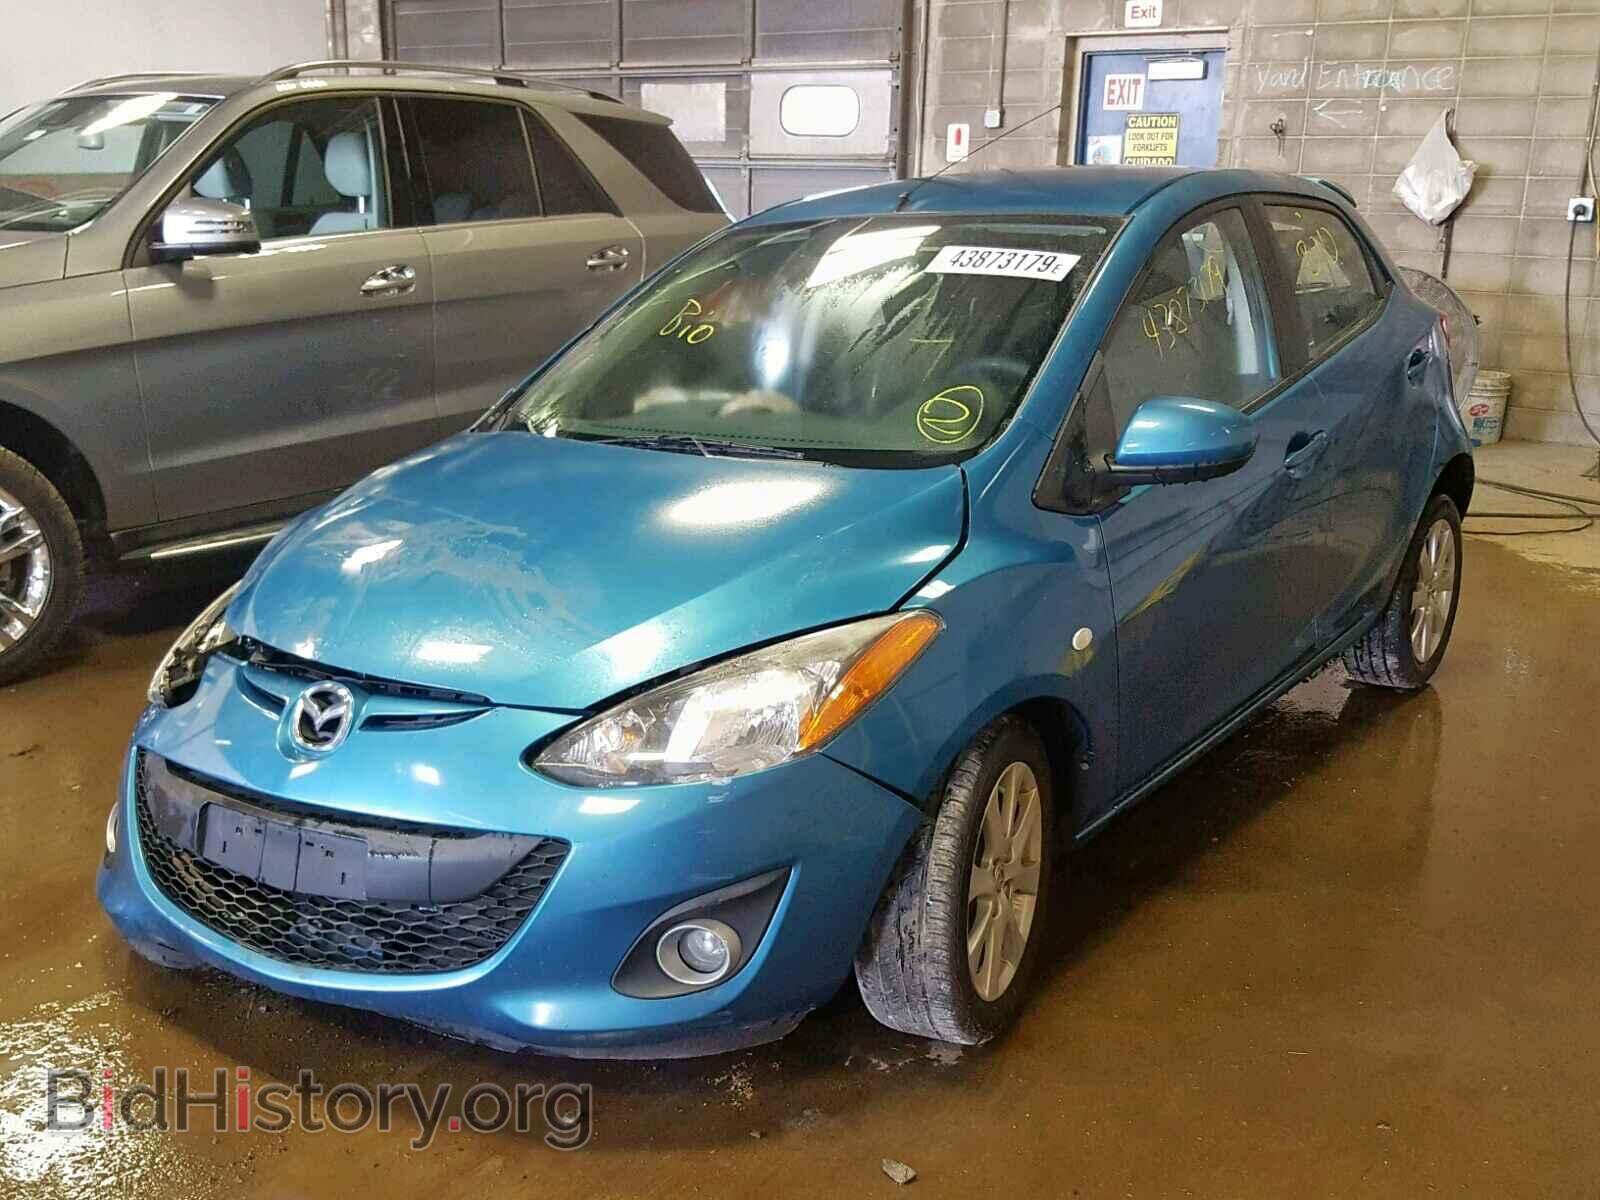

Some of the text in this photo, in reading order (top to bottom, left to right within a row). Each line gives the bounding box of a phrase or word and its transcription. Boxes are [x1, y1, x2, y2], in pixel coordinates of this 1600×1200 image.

[1131, 5, 1157, 19] Exit
[1106, 78, 1141, 105] EXIT
[1128, 115, 1177, 128] CAUTION
[1128, 132, 1146, 141] LOOK
[1160, 132, 1174, 140] FOR
[1132, 143, 1168, 151] FORKLIFTS
